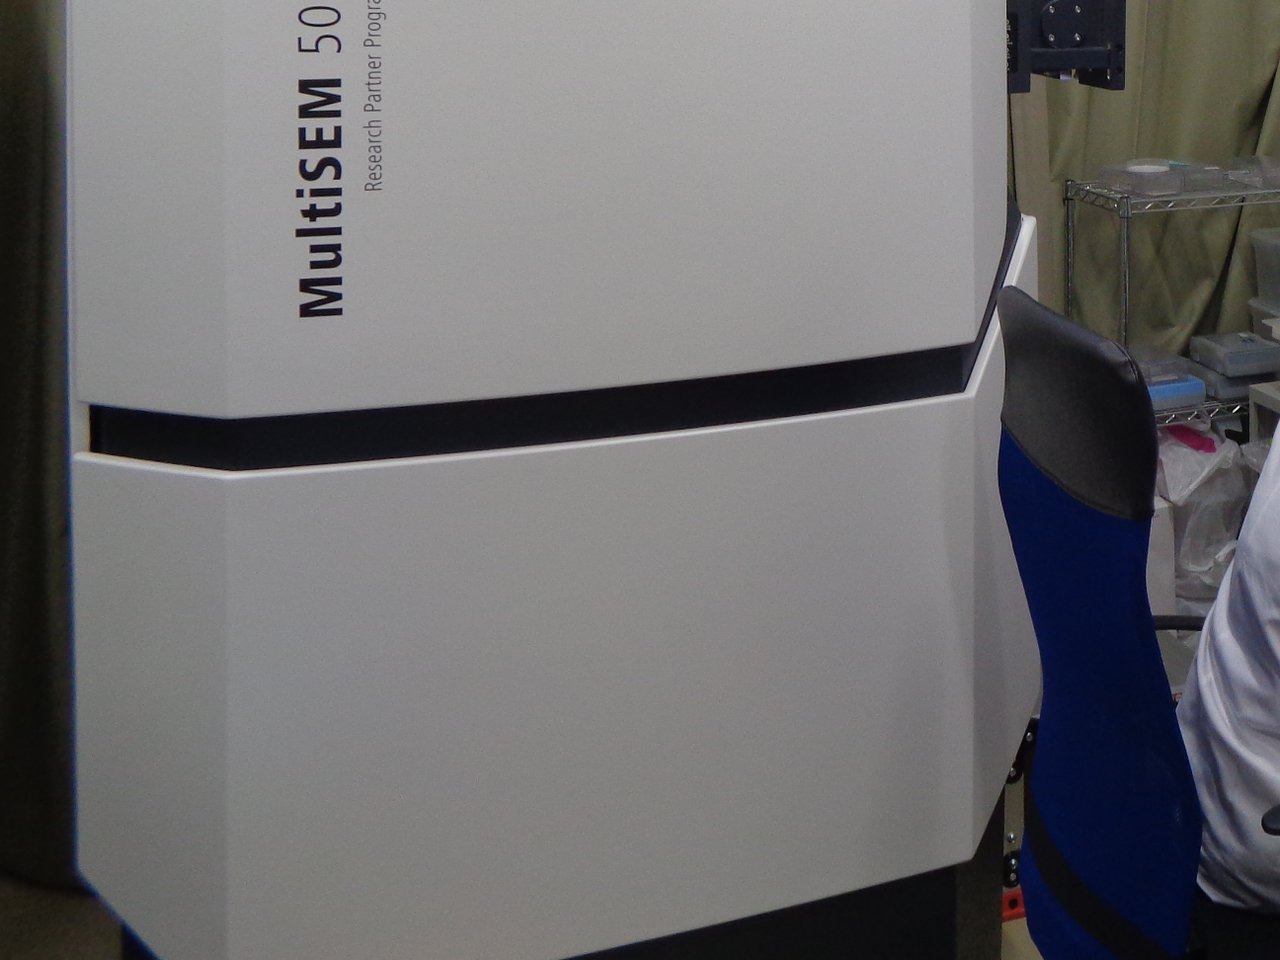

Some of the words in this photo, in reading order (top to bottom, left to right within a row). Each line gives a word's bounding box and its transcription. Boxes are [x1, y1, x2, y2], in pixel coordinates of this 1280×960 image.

[363, 54, 381, 112] Partner
[363, 120, 382, 192] Research
[295, 78, 343, 318] MultiSEM
